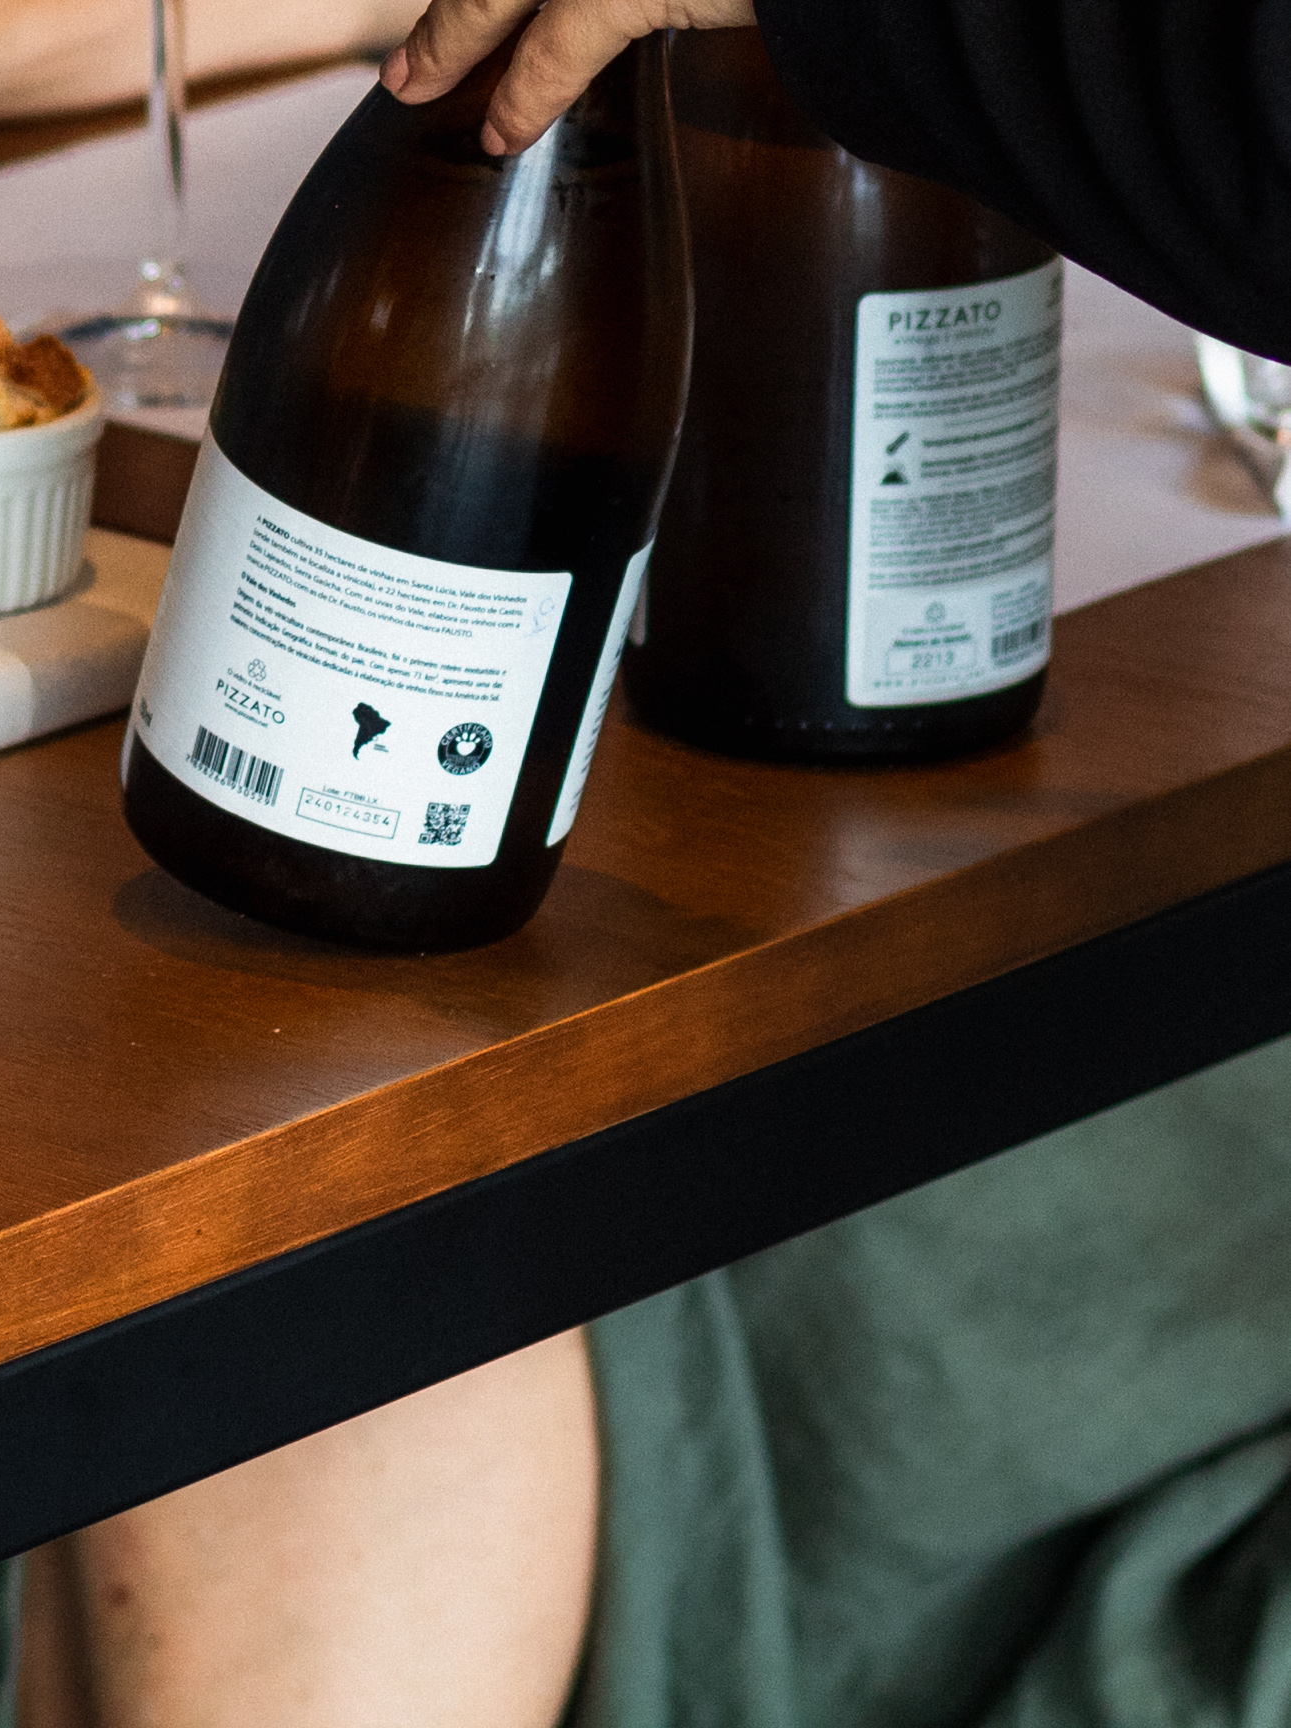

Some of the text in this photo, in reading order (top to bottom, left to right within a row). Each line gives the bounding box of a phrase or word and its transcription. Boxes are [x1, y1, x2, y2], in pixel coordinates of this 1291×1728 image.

[889, 301, 1001, 331] PIZZATO
[262, 518, 290, 540] PIZZATO
[290, 536, 313, 552] cultiva
[314, 546, 323, 556] 35
[324, 551, 356, 570] hectares
[358, 564, 368, 573] de
[370, 569, 395, 582] vinhas
[412, 580, 433, 592] Santa
[460, 590, 475, 599] Vale
[477, 592, 491, 601] dos
[493, 594, 527, 603] Vinhedos
[250, 540, 263, 554] Dois
[294, 566, 312, 580] Serra
[344, 587, 363, 599] Com
[375, 599, 393, 608] uvas
[428, 611, 458, 623] elabora
[471, 618, 496, 628] vinhos
[271, 539, 298, 558] também
[308, 557, 335, 576] localiza
[385, 587, 396, 596] 22
[397, 590, 430, 604] hectares
[460, 603, 486, 614] Fausto
[269, 588, 296, 608] Vinhedos
[294, 581, 309, 593] com
[317, 591, 328, 602] de
[378, 613, 403, 626] vinhos
[405, 619, 415, 628] da
[416, 621, 440, 633] marca
[369, 661, 384, 671] Com
[409, 658, 438, 669] primeiro
[216, 679, 285, 724] PIZZATO
[405, 684, 427, 694] vinhos
[427, 687, 444, 697] finos
[441, 723, 492, 749] CERTIFICADO
[442, 759, 481, 775] VEGANO
[305, 794, 390, 826] 240124354
